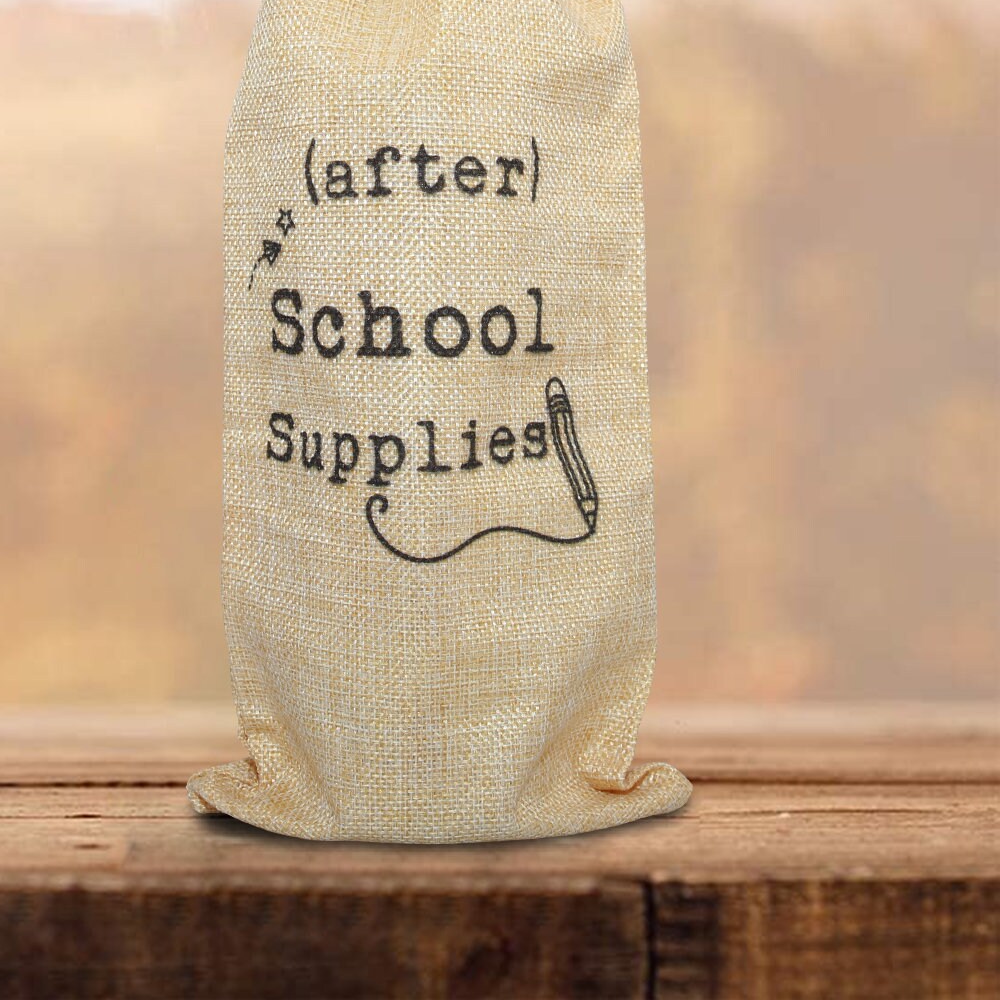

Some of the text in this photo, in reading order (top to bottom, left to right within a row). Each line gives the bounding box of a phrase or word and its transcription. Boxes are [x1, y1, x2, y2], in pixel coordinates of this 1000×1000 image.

[304, 136, 540, 205] (after)
[269, 287, 555, 359] School
[265, 412, 548, 487] Supplies
